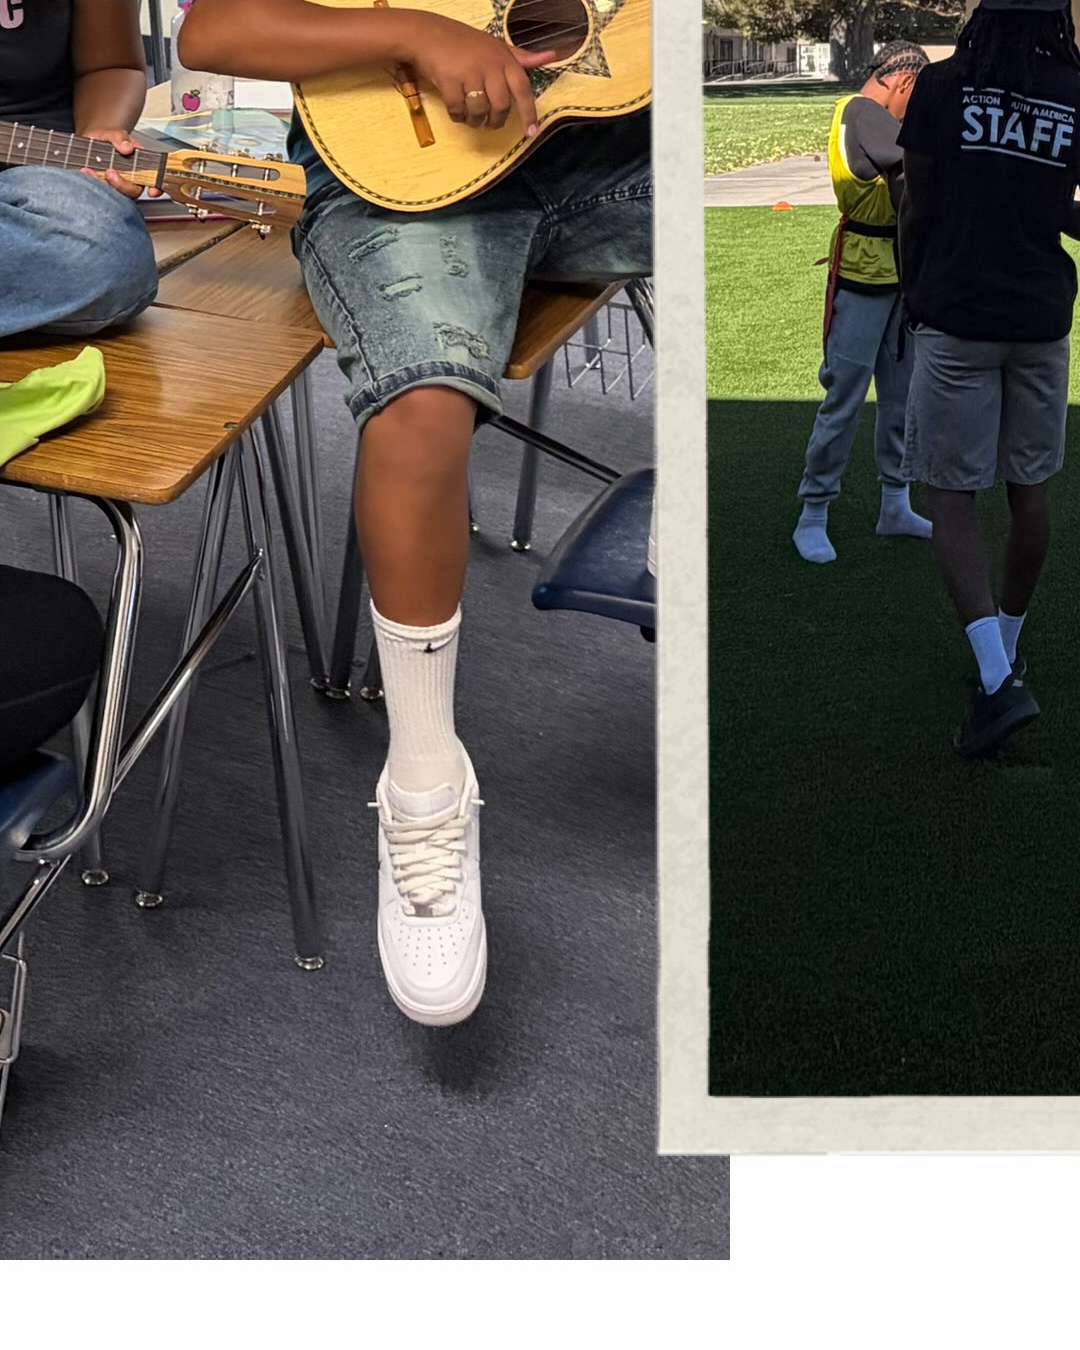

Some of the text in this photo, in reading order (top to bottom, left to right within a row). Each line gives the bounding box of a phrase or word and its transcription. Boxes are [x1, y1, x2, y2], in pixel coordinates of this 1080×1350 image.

[962, 94, 1001, 106] ACTION
[1032, 107, 1075, 124] AMERICA
[961, 105, 1074, 158] STAFF
